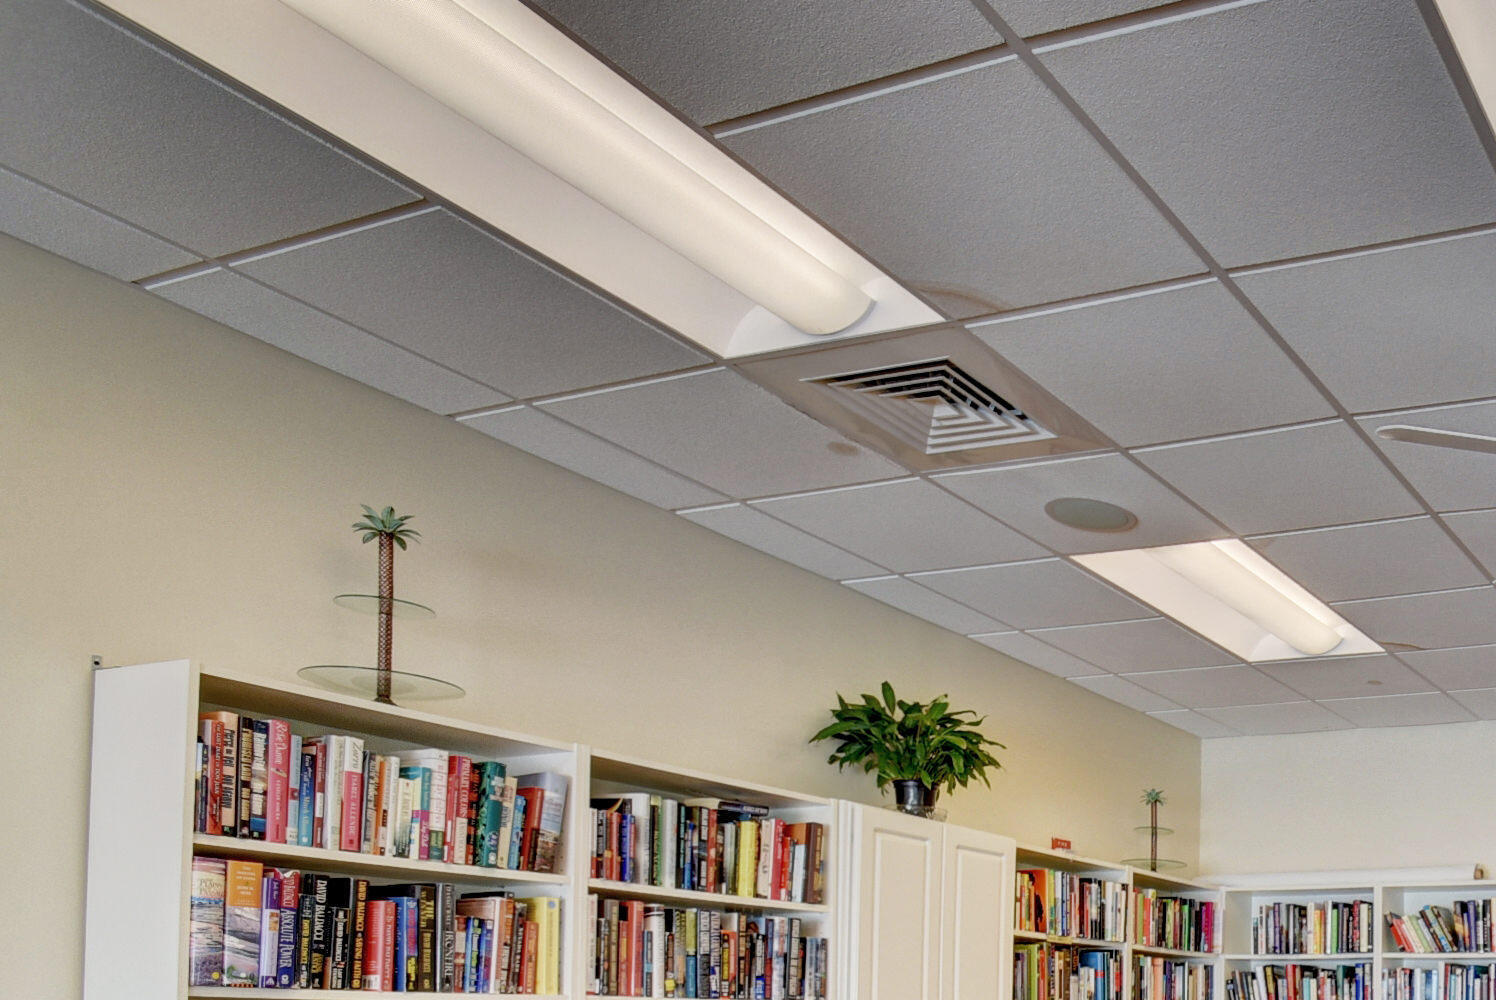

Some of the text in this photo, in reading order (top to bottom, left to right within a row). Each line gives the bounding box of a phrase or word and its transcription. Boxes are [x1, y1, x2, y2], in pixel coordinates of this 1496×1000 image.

[460, 758, 470, 818] PRIMARY COLORS
[349, 802, 357, 835] ALLENDE
[314, 880, 327, 940] DAVID BALDACCI
[356, 901, 366, 932] BALDACCI
[426, 900, 434, 919] THE
[280, 910, 295, 967] ABSOLUTE POWER
[301, 919, 310, 964] DAVID BALDACCI
[335, 923, 344, 961] DAVID BALDACCI
[354, 937, 362, 959] SAVING
[444, 930, 453, 978] IRONFIRE
[354, 961, 362, 979] FAITH
